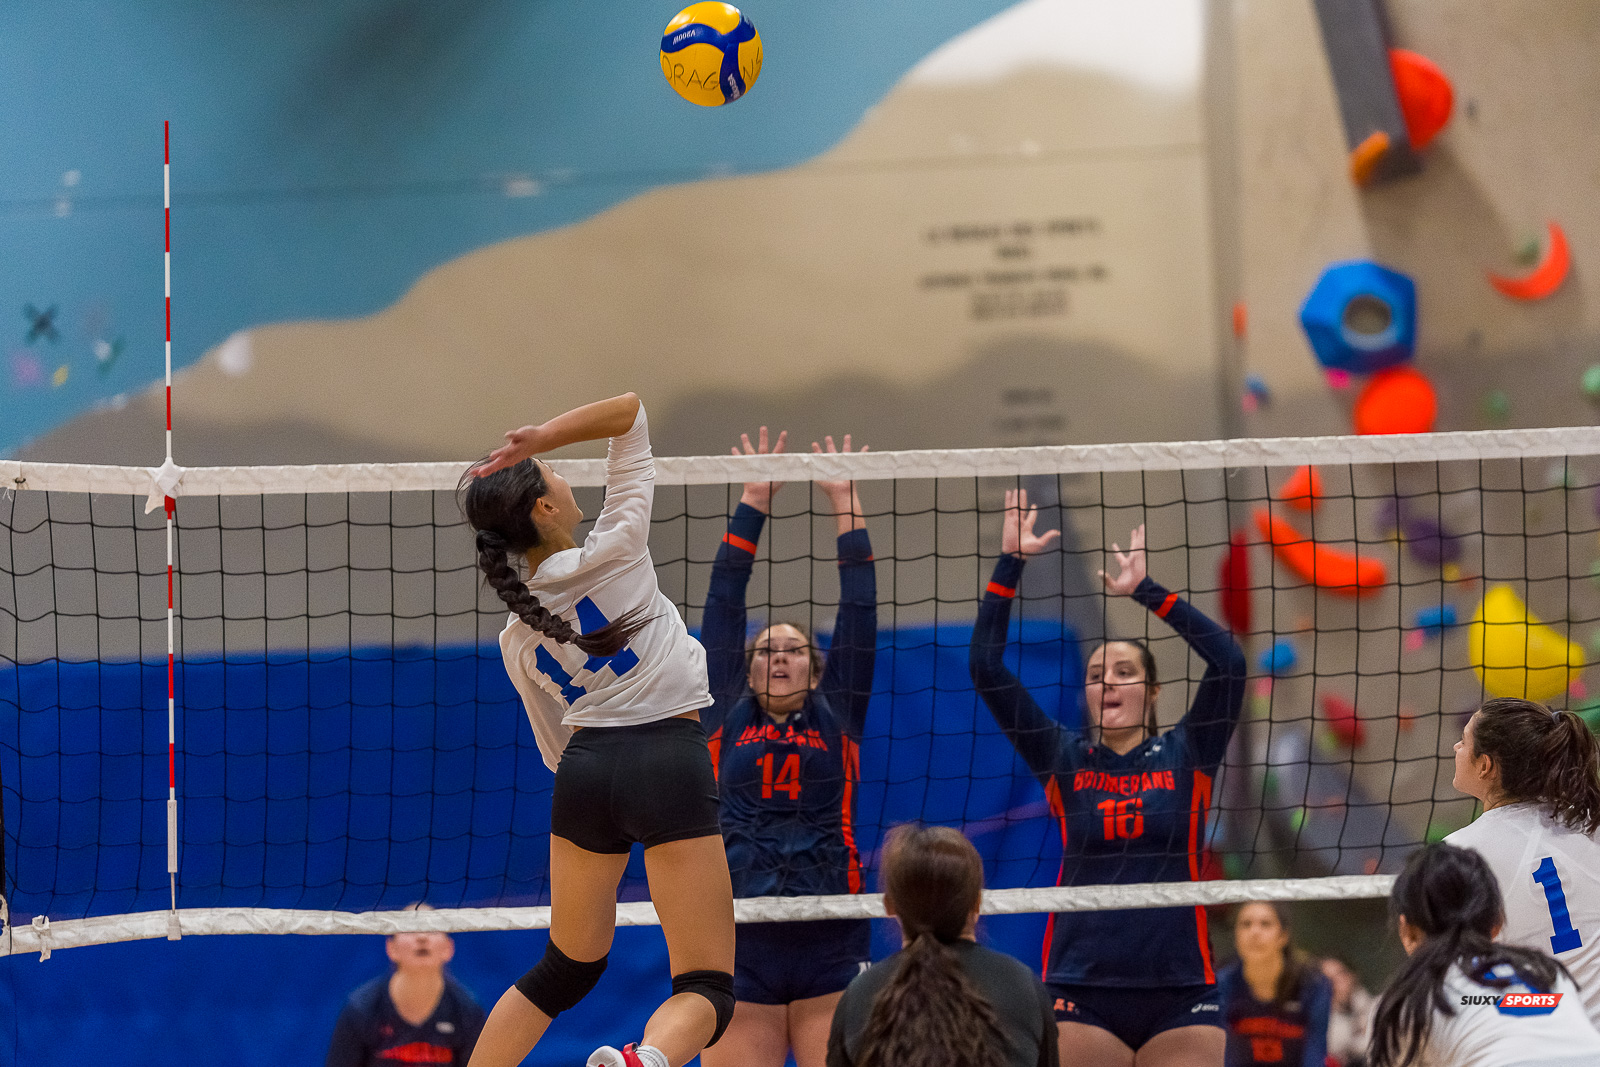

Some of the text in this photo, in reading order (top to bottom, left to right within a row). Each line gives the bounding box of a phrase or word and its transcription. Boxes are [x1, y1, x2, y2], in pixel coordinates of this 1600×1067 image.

[535, 595, 640, 706] 14
[756, 753, 801, 800] 14
[1073, 769, 1175, 796] BOOMERANG
[1097, 798, 1144, 841] 16
[1532, 857, 1583, 955] 1
